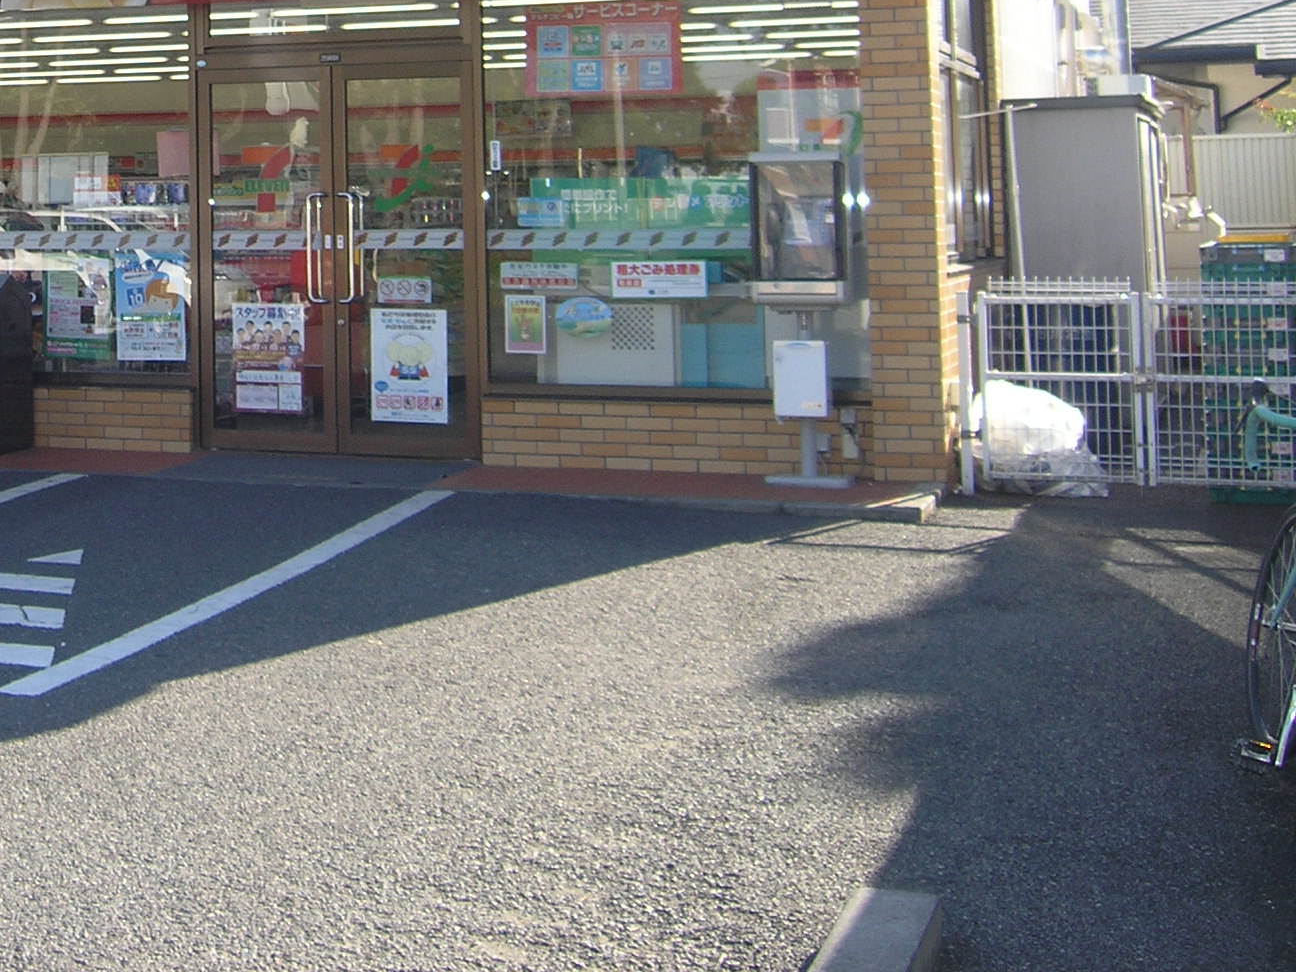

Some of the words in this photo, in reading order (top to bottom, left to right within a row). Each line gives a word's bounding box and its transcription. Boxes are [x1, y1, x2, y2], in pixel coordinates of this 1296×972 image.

[573, 2, 678, 19] サービスコーナー
